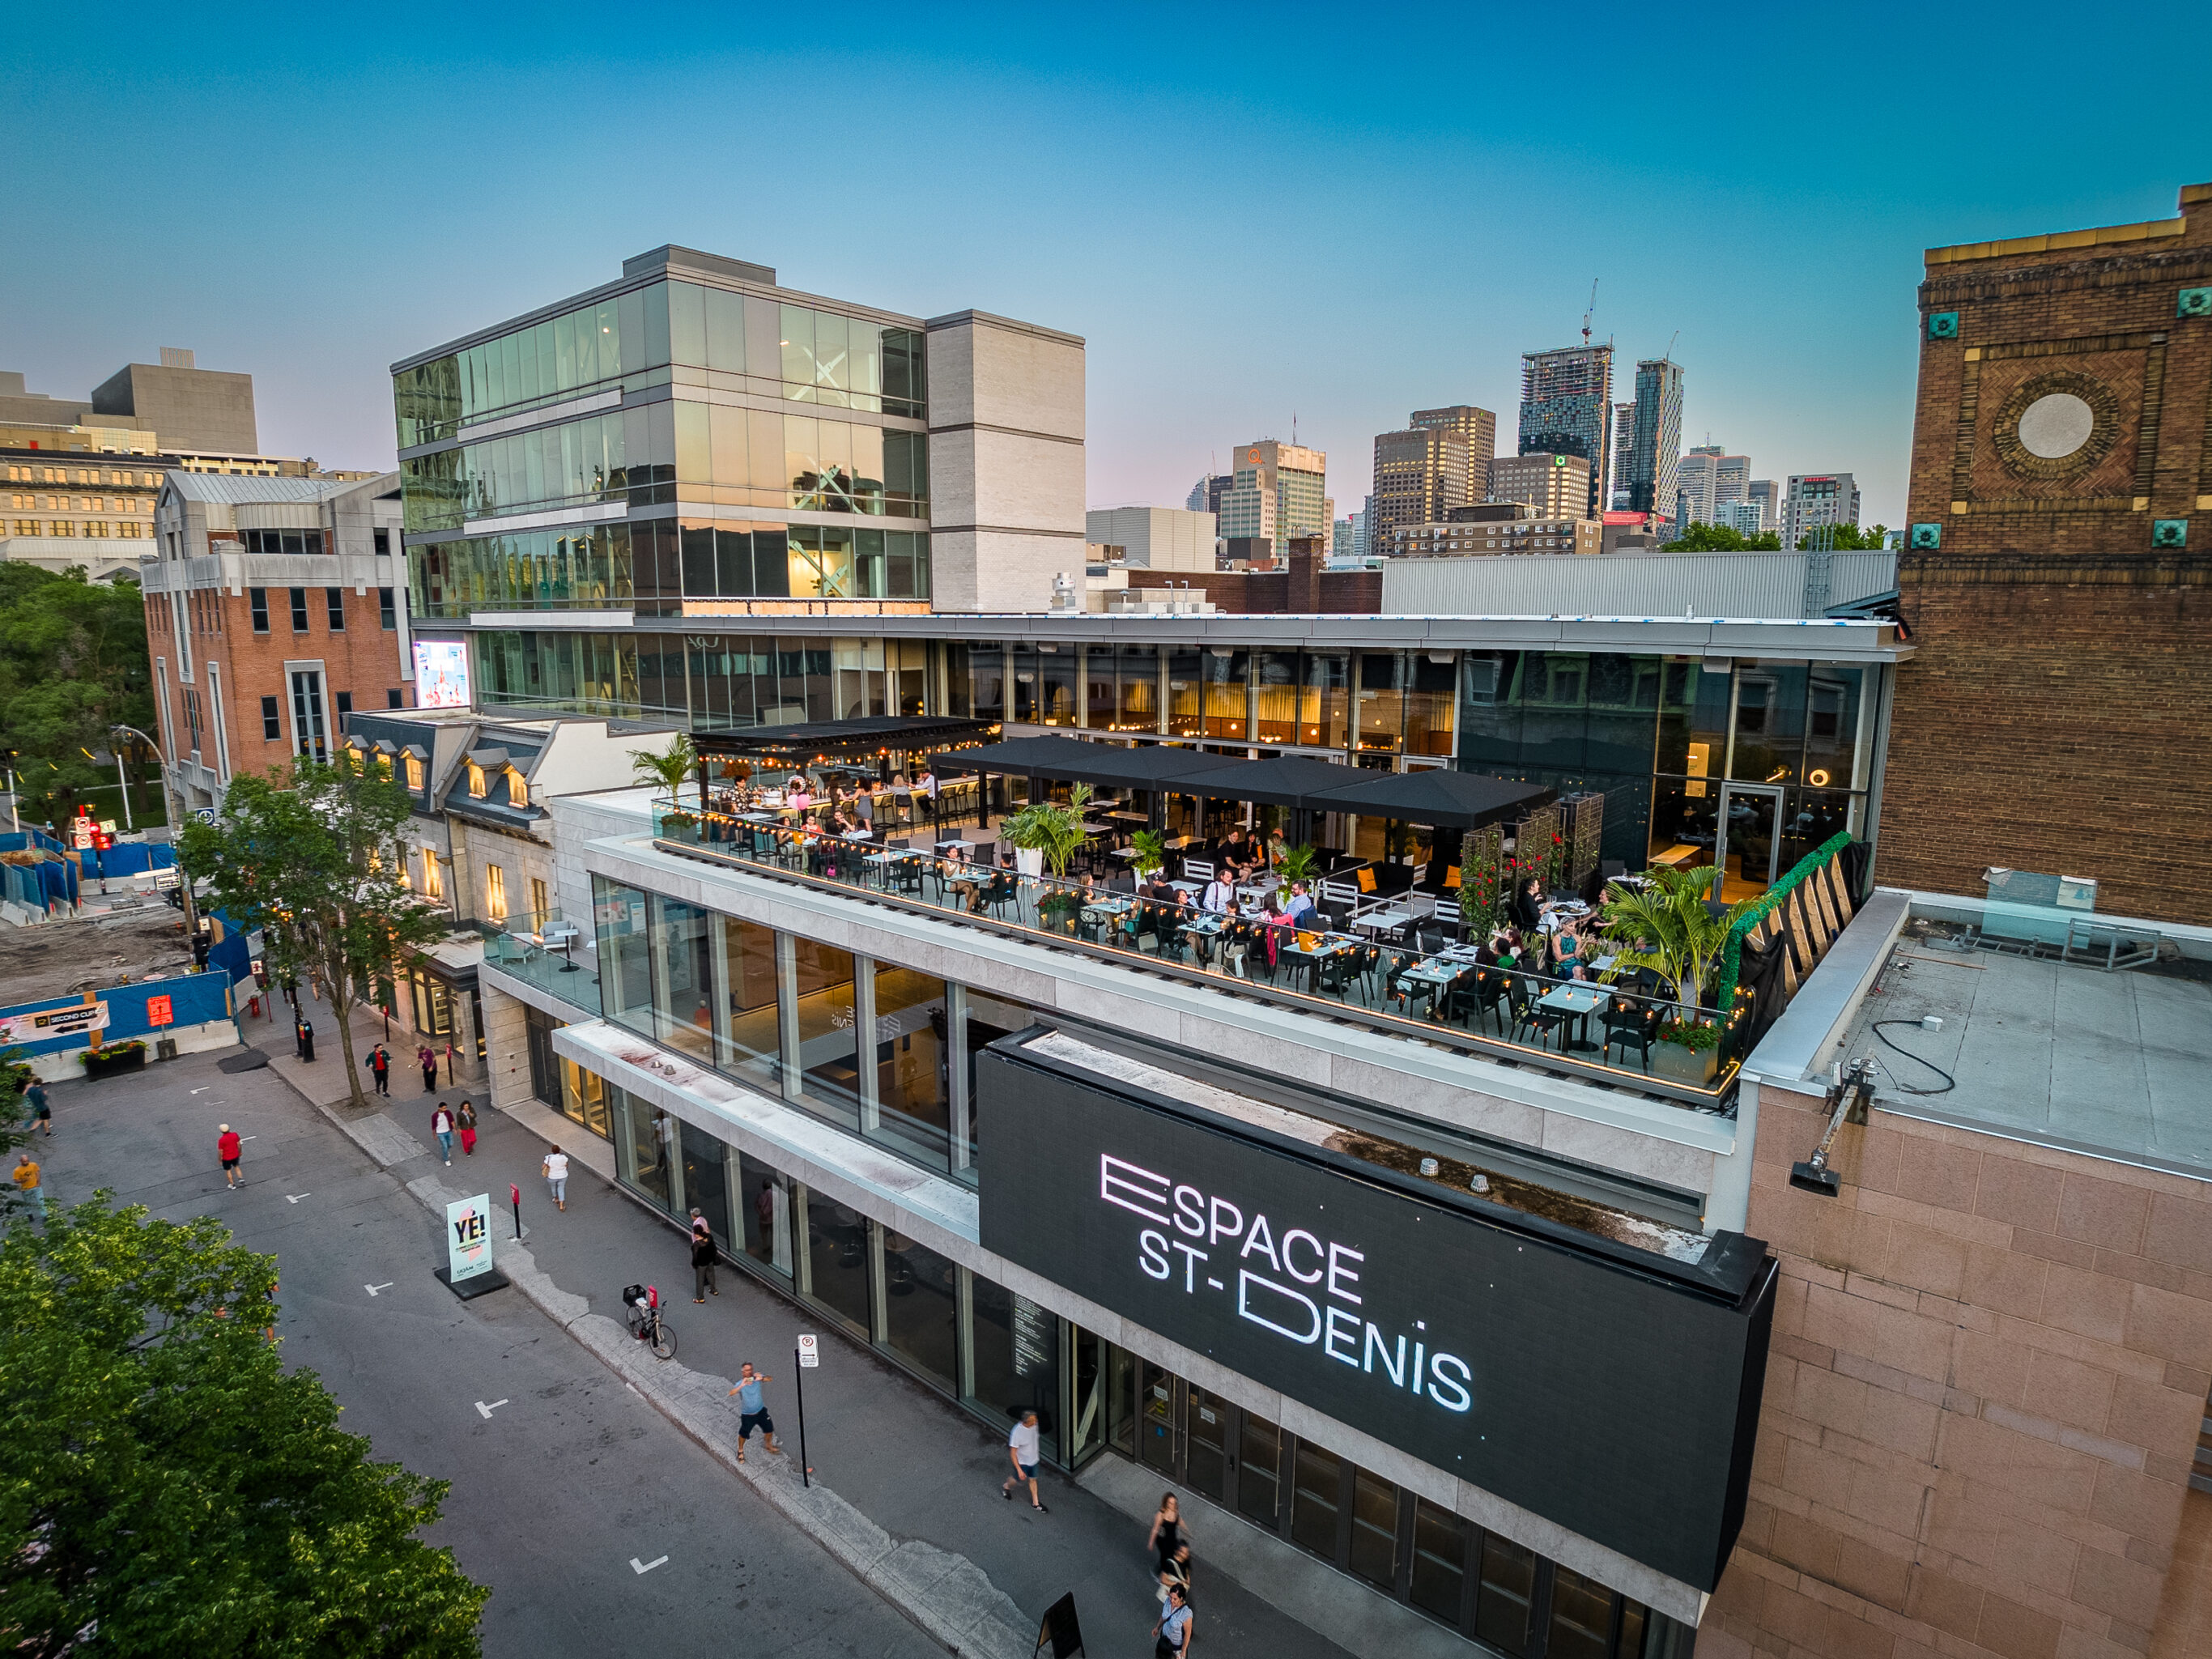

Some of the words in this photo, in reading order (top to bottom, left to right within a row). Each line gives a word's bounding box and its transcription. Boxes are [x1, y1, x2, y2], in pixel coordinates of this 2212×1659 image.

[50, 1012, 79, 1023] SECOND
[79, 1010, 94, 1019] CUP
[1100, 1153, 1365, 1305] ESPACE
